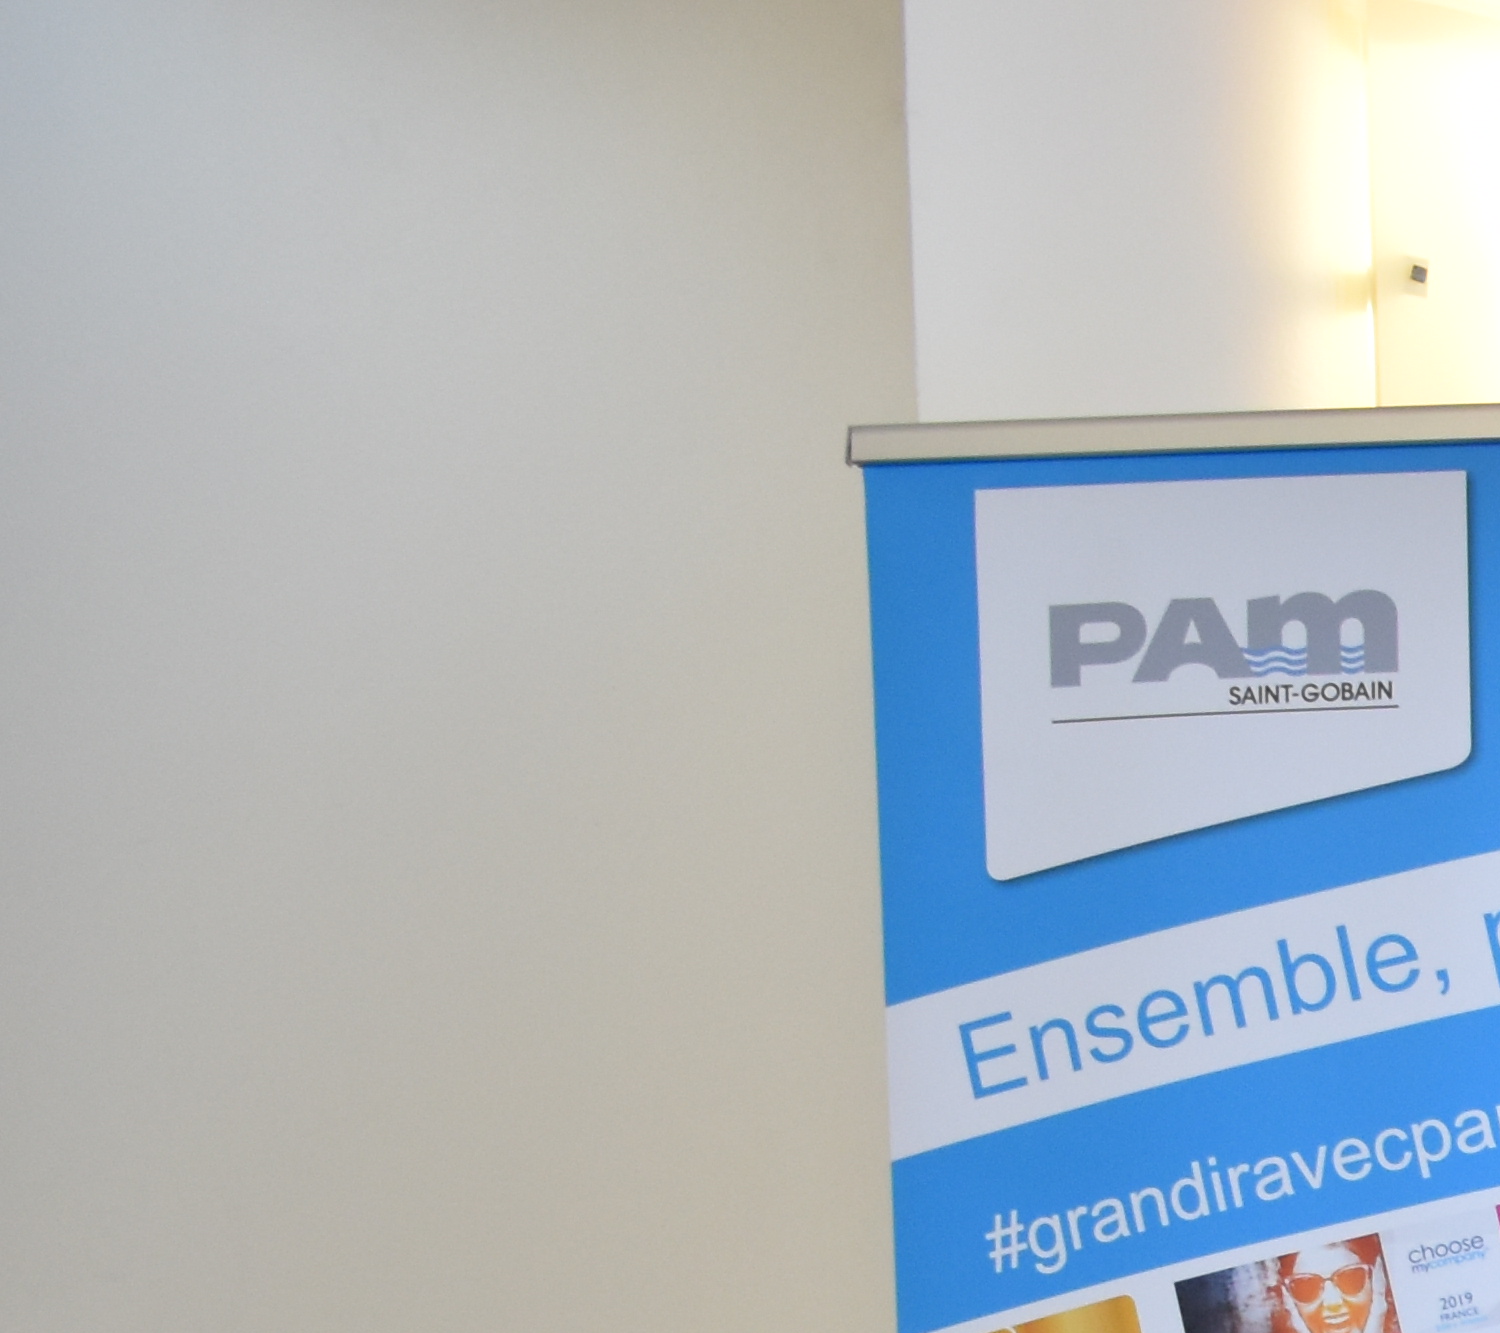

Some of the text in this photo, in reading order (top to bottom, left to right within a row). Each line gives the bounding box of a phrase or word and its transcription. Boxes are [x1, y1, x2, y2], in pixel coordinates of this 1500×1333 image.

[1228, 680, 1394, 706] SAINT-GOBAIN
[957, 925, 1450, 1100] Ensemble,
[1408, 1234, 1484, 1264] choose
[1439, 1291, 1473, 1311] 2019
[1439, 1307, 1480, 1323] FRANCE
